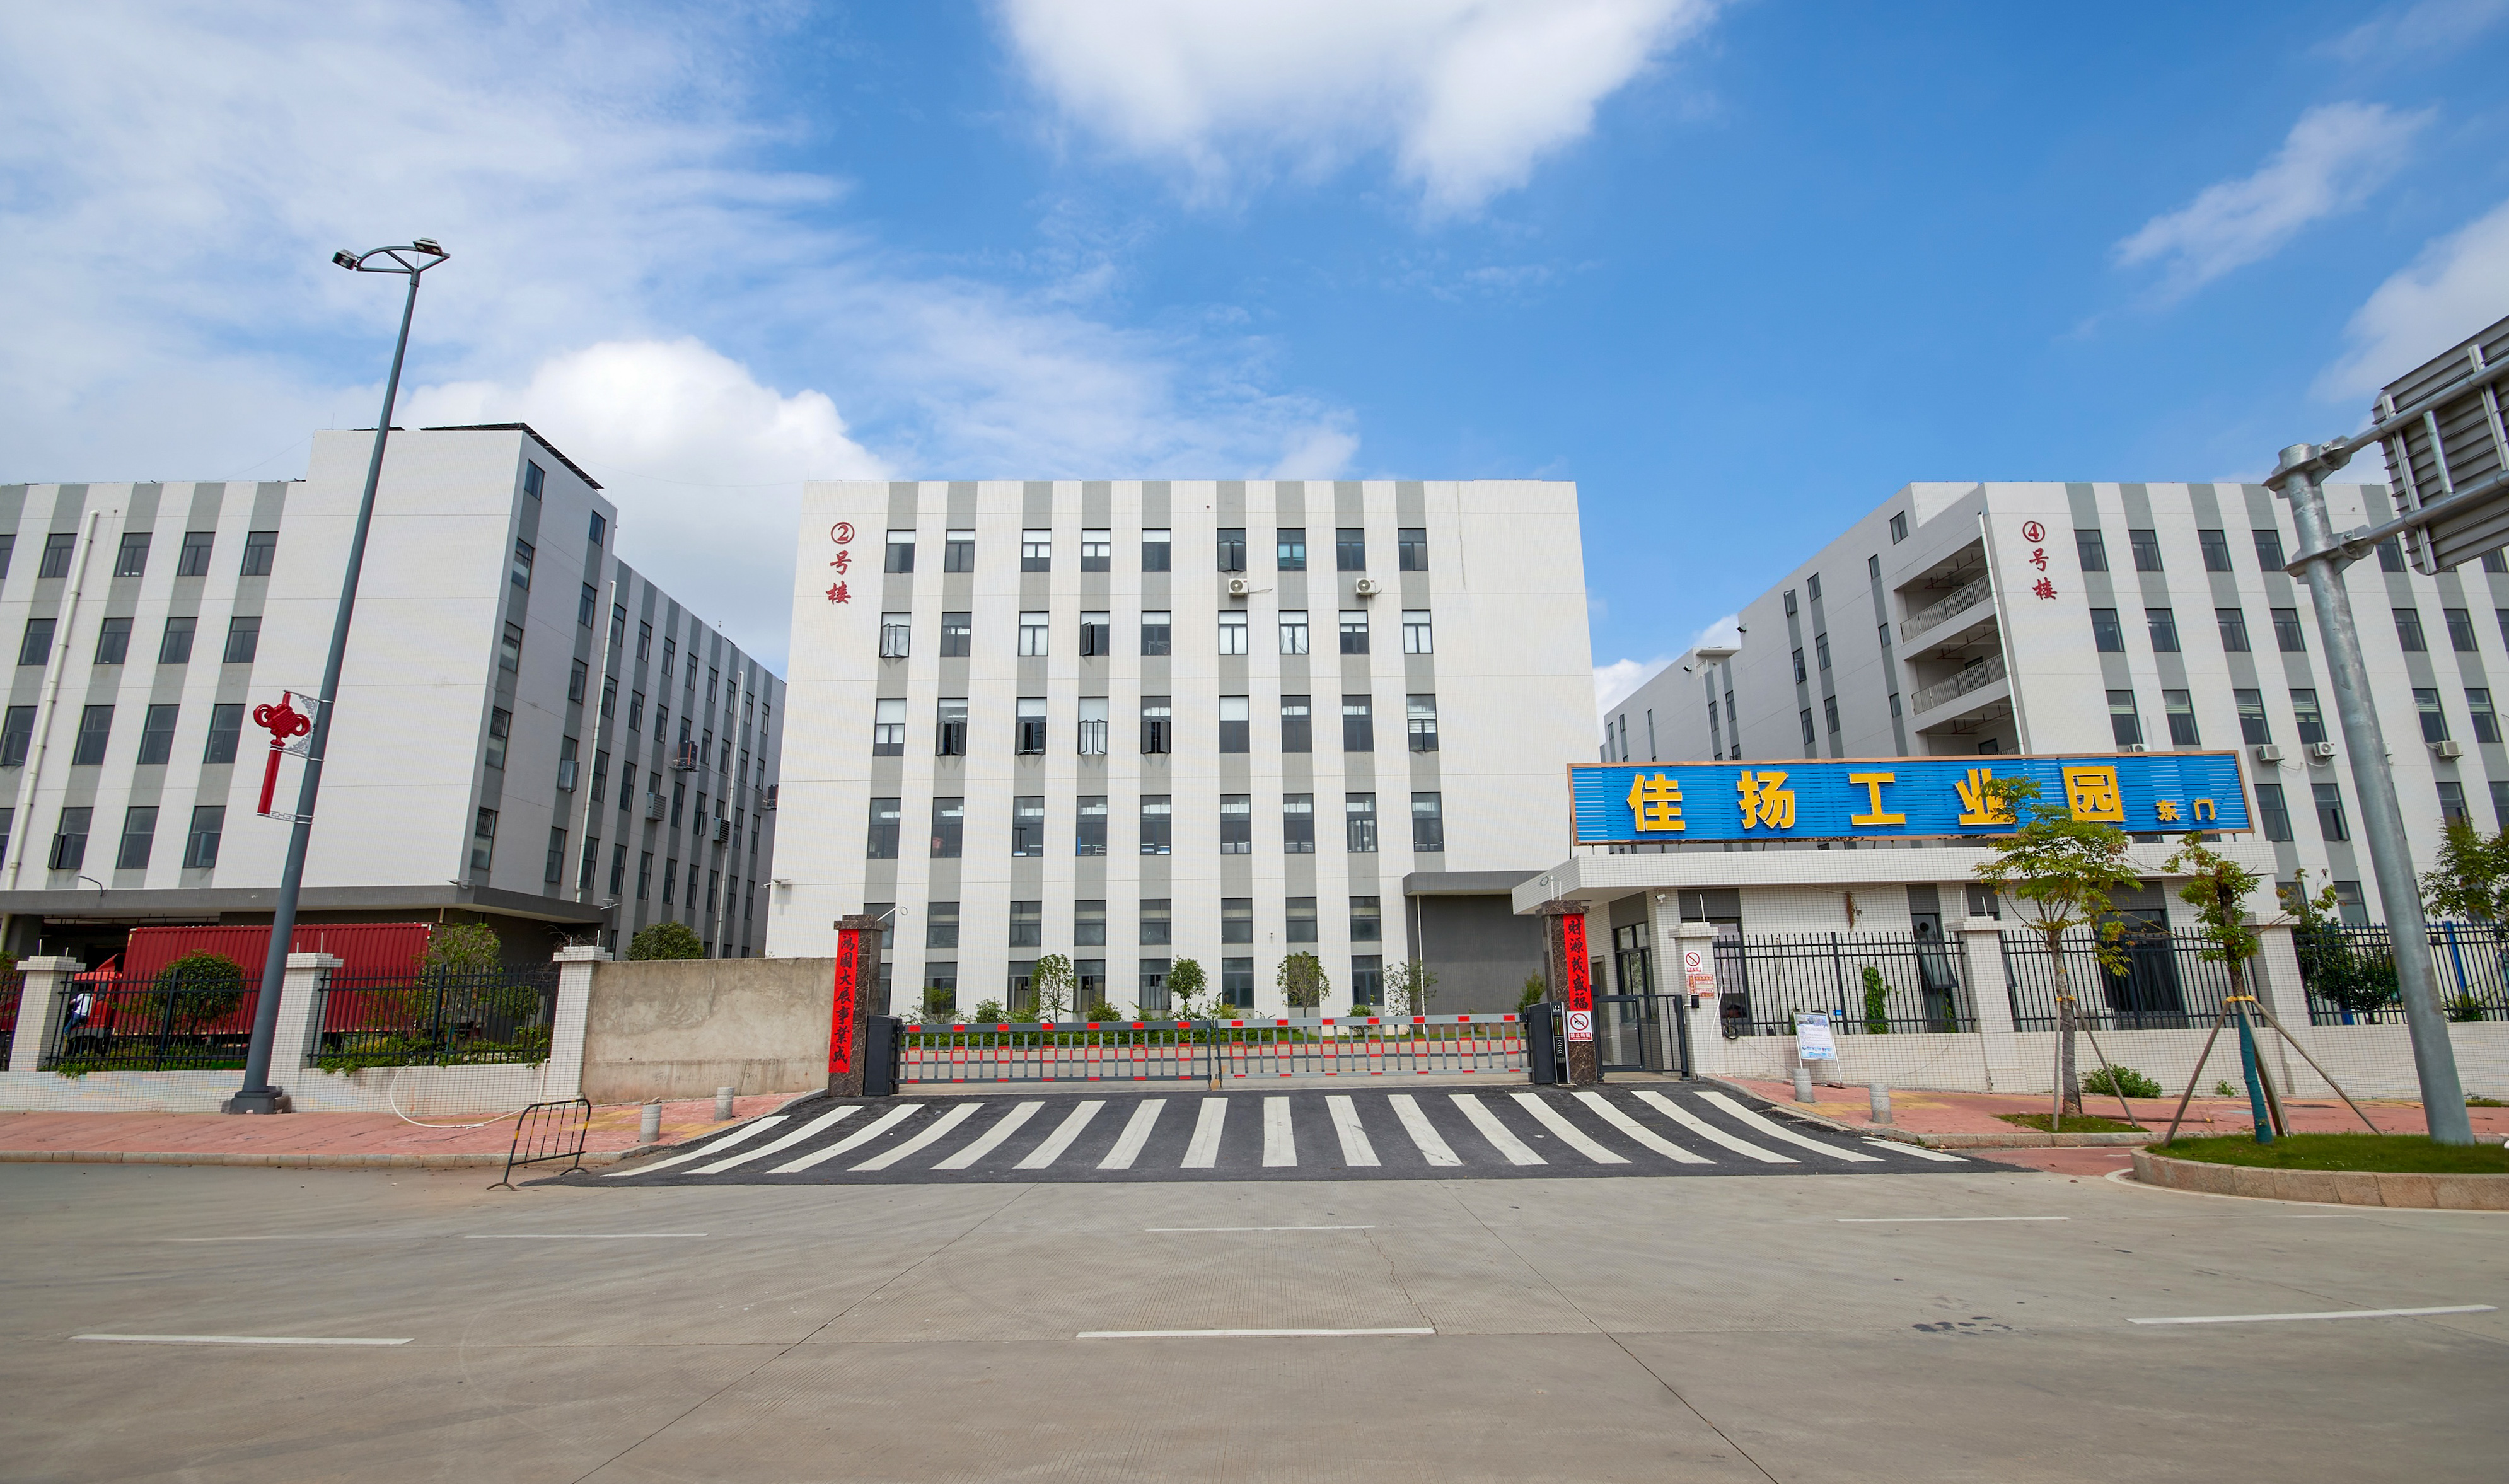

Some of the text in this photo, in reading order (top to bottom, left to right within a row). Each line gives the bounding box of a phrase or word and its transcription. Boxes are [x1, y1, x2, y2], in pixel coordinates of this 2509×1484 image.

[1627, 765, 2216, 832] 佳扬工业园 东门
